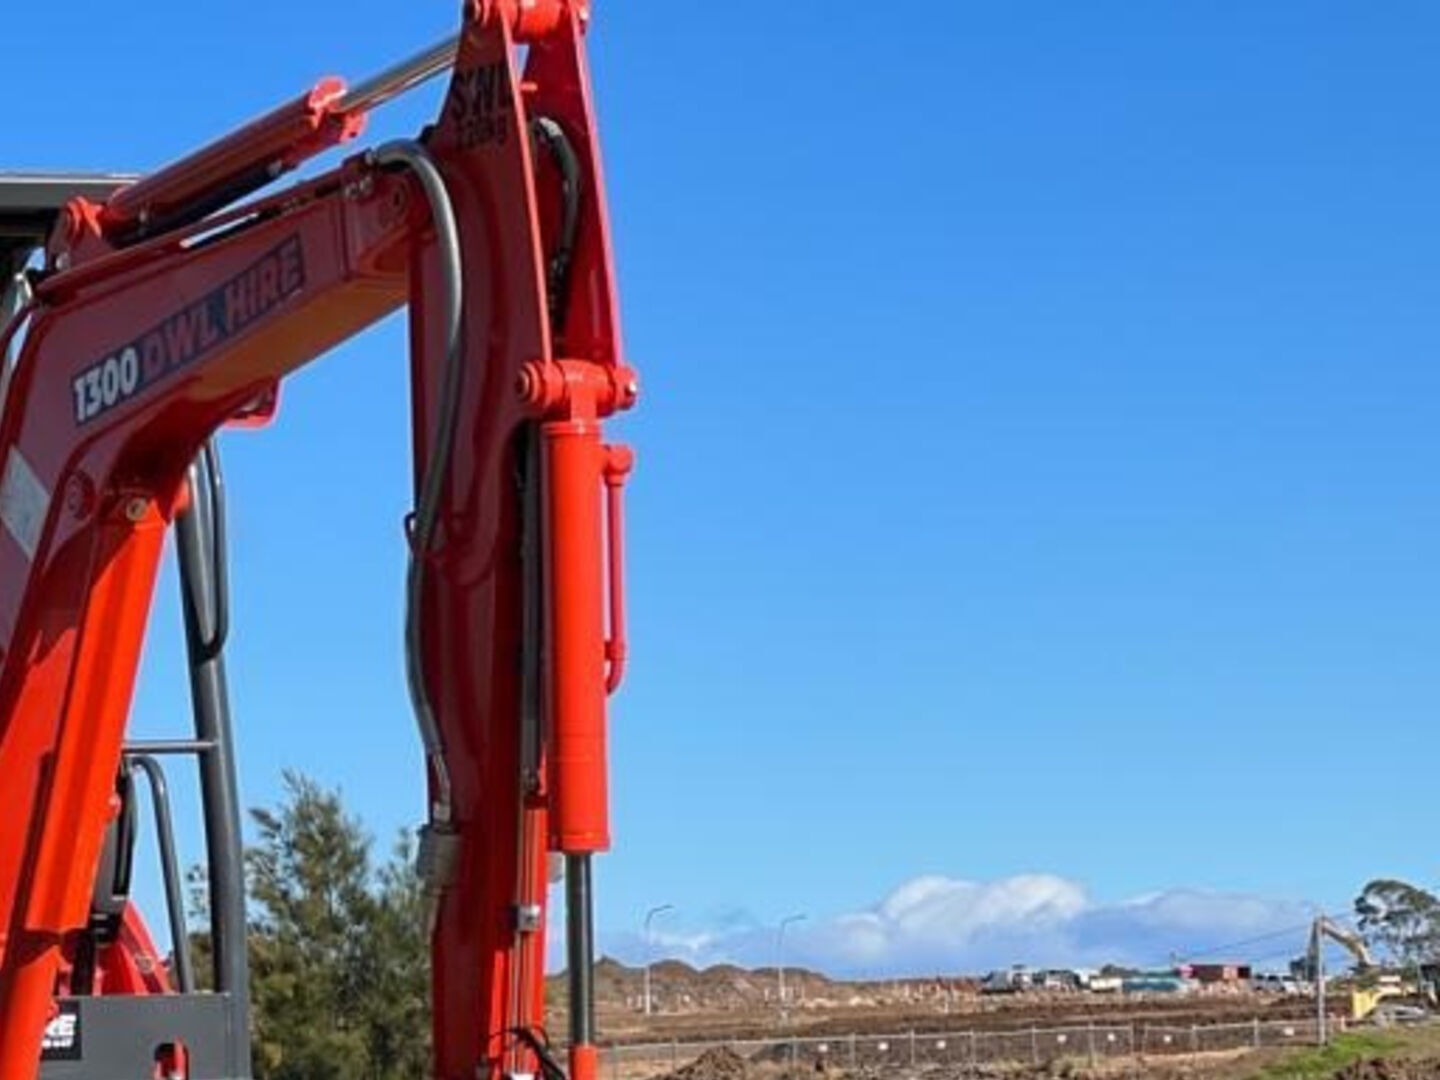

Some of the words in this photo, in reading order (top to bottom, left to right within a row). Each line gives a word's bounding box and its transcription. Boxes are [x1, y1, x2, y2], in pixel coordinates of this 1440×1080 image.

[74, 346, 139, 422] 1300
[143, 305, 219, 386] DWL
[224, 238, 300, 335] HIRE
